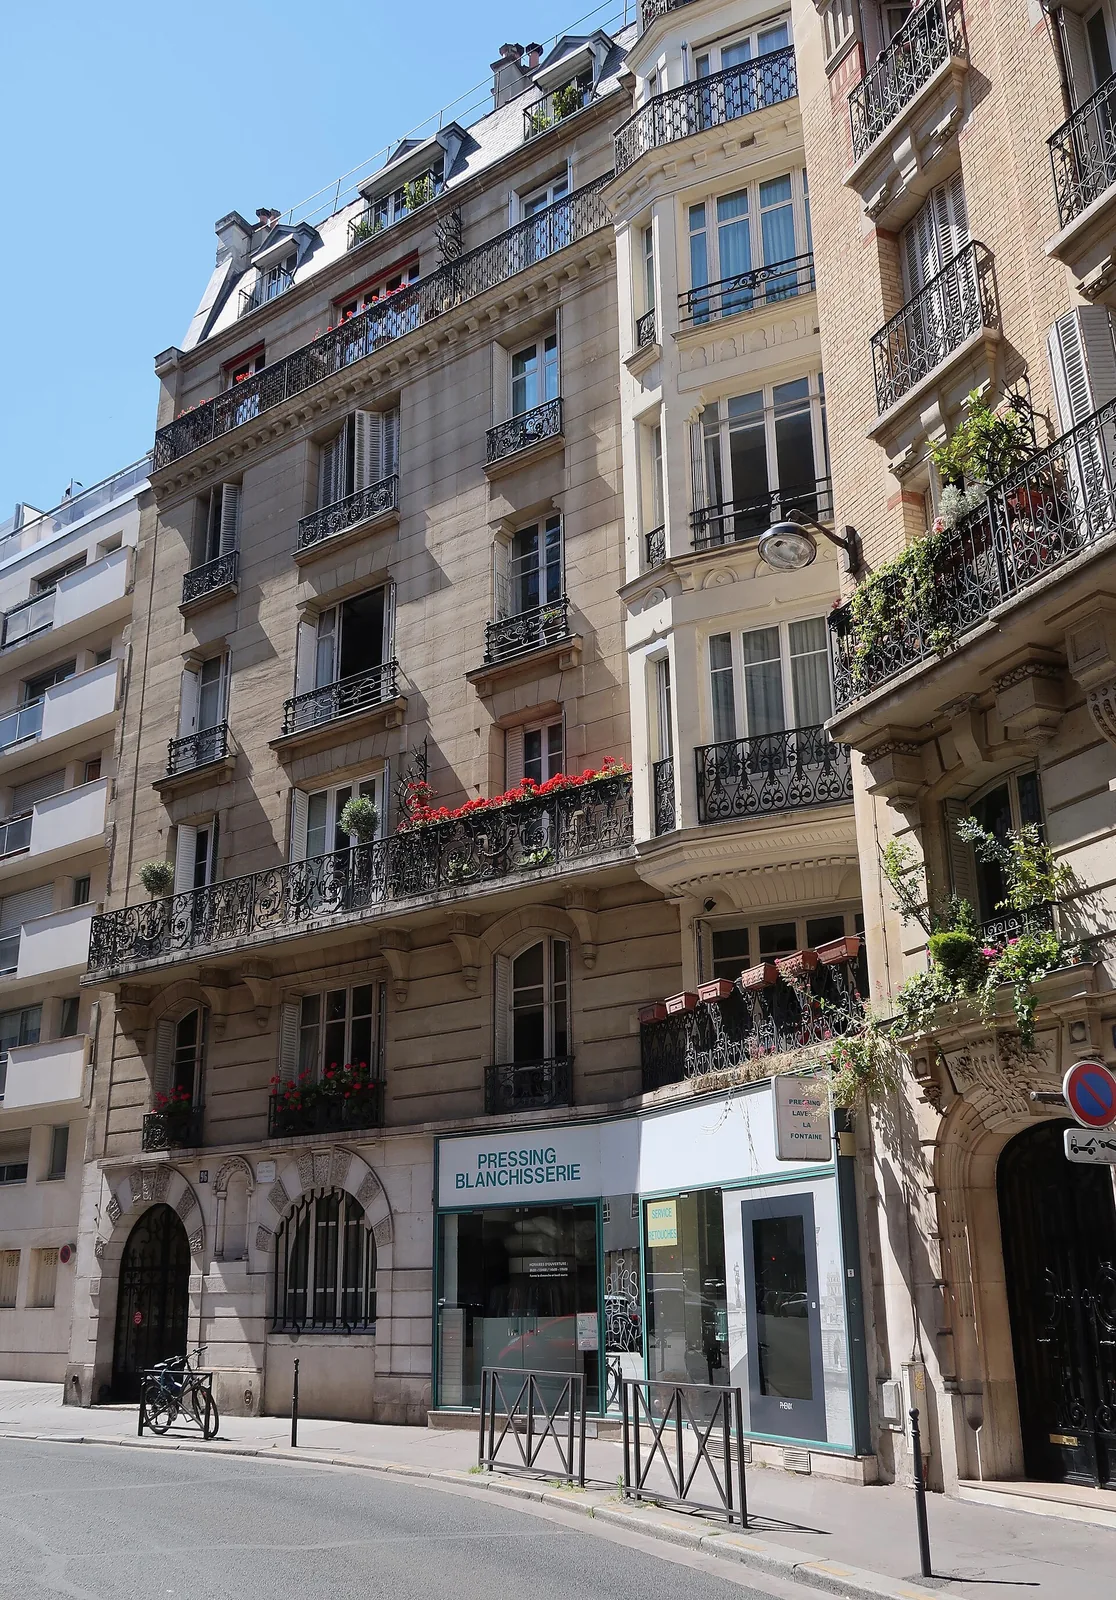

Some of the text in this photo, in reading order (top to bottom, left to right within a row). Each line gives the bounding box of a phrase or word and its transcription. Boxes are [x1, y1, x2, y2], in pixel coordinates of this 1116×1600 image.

[790, 1132, 822, 1140] FONTAINE
[477, 1147, 556, 1169] PRESSING
[455, 1163, 581, 1189] BLANCHISSERIE
[652, 1207, 672, 1219] SERVICE
[648, 1228, 677, 1240] RETOUCHES
